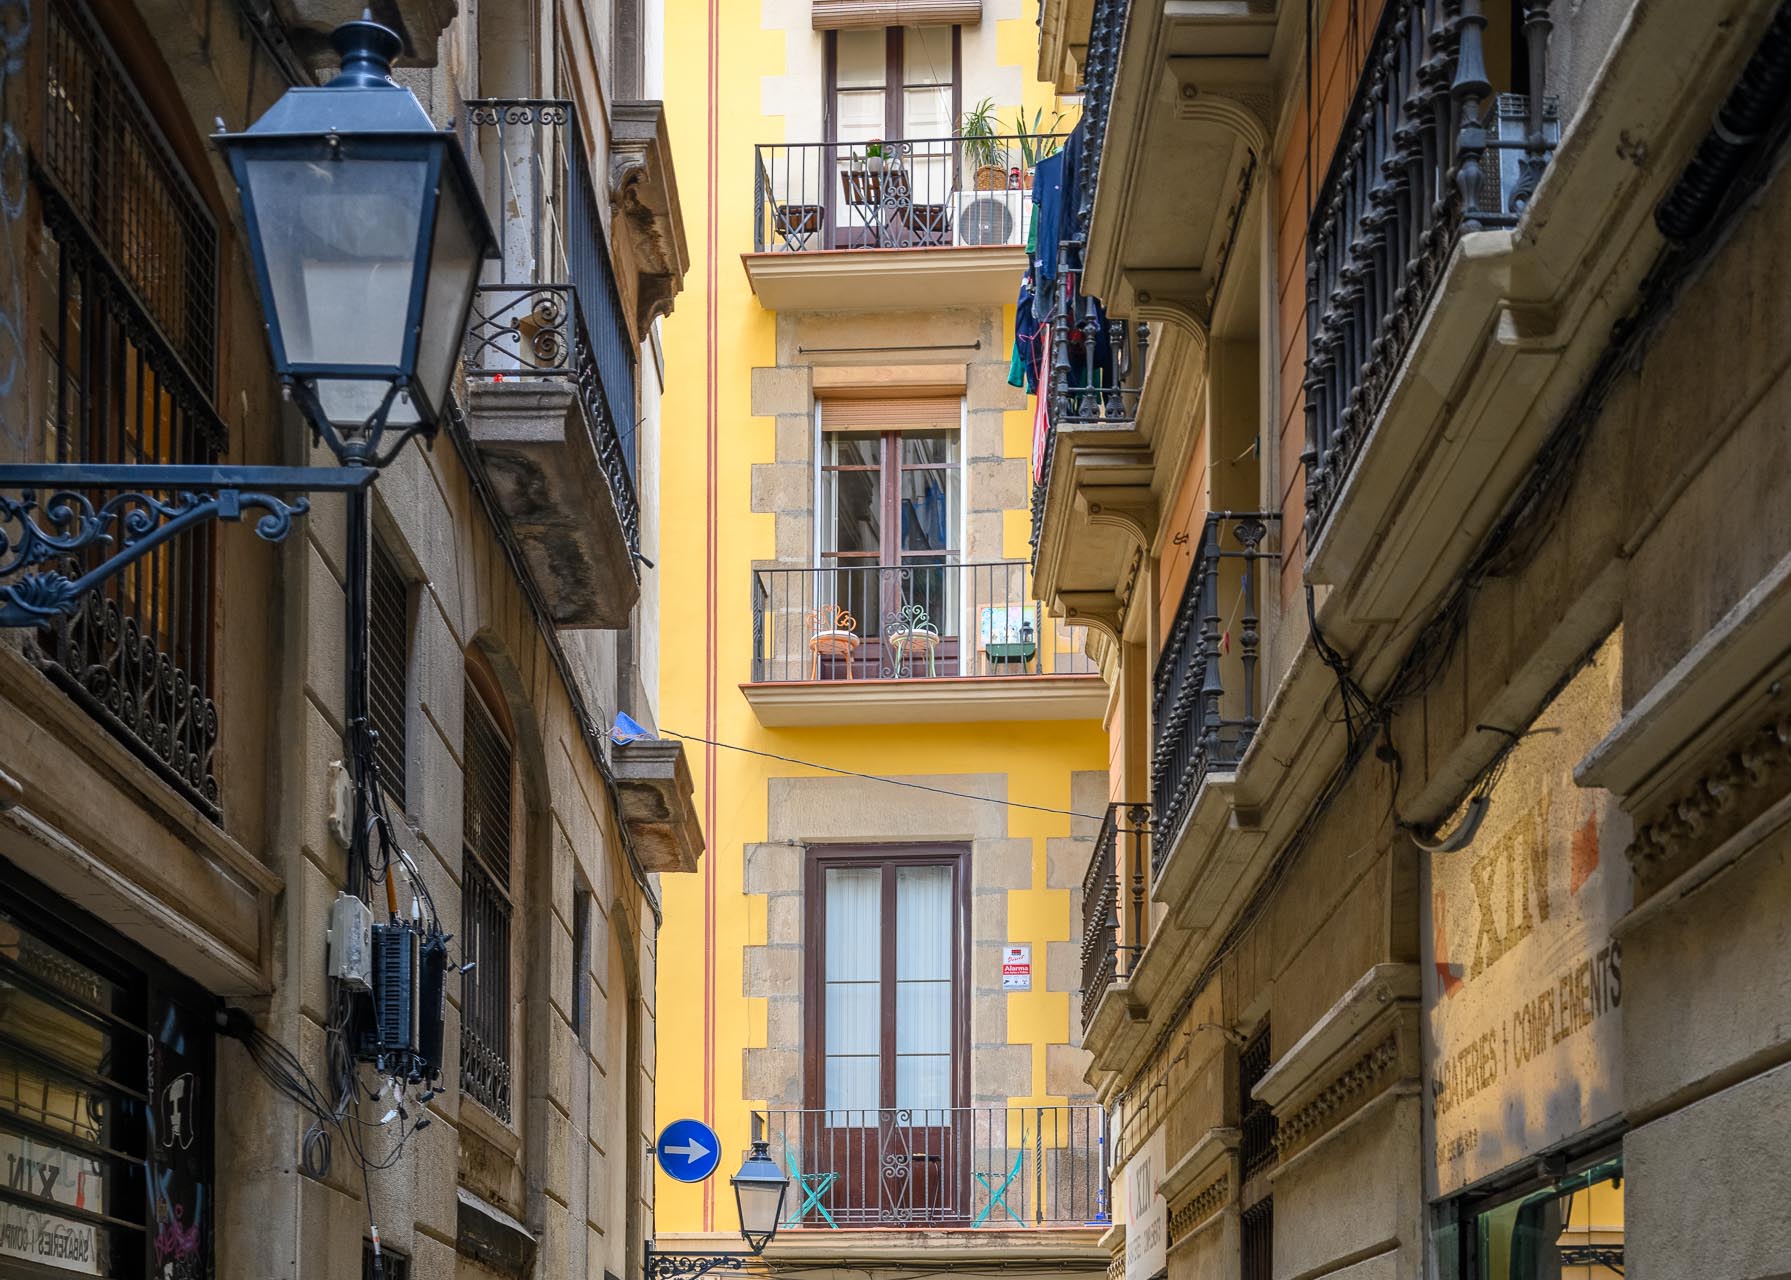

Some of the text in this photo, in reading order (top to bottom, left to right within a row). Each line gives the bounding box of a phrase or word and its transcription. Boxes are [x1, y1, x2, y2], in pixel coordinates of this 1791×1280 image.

[1471, 798, 1550, 982] XIN
[1512, 939, 1622, 1070] COMPLEMENTS
[1136, 1155, 1151, 1220] XIN
